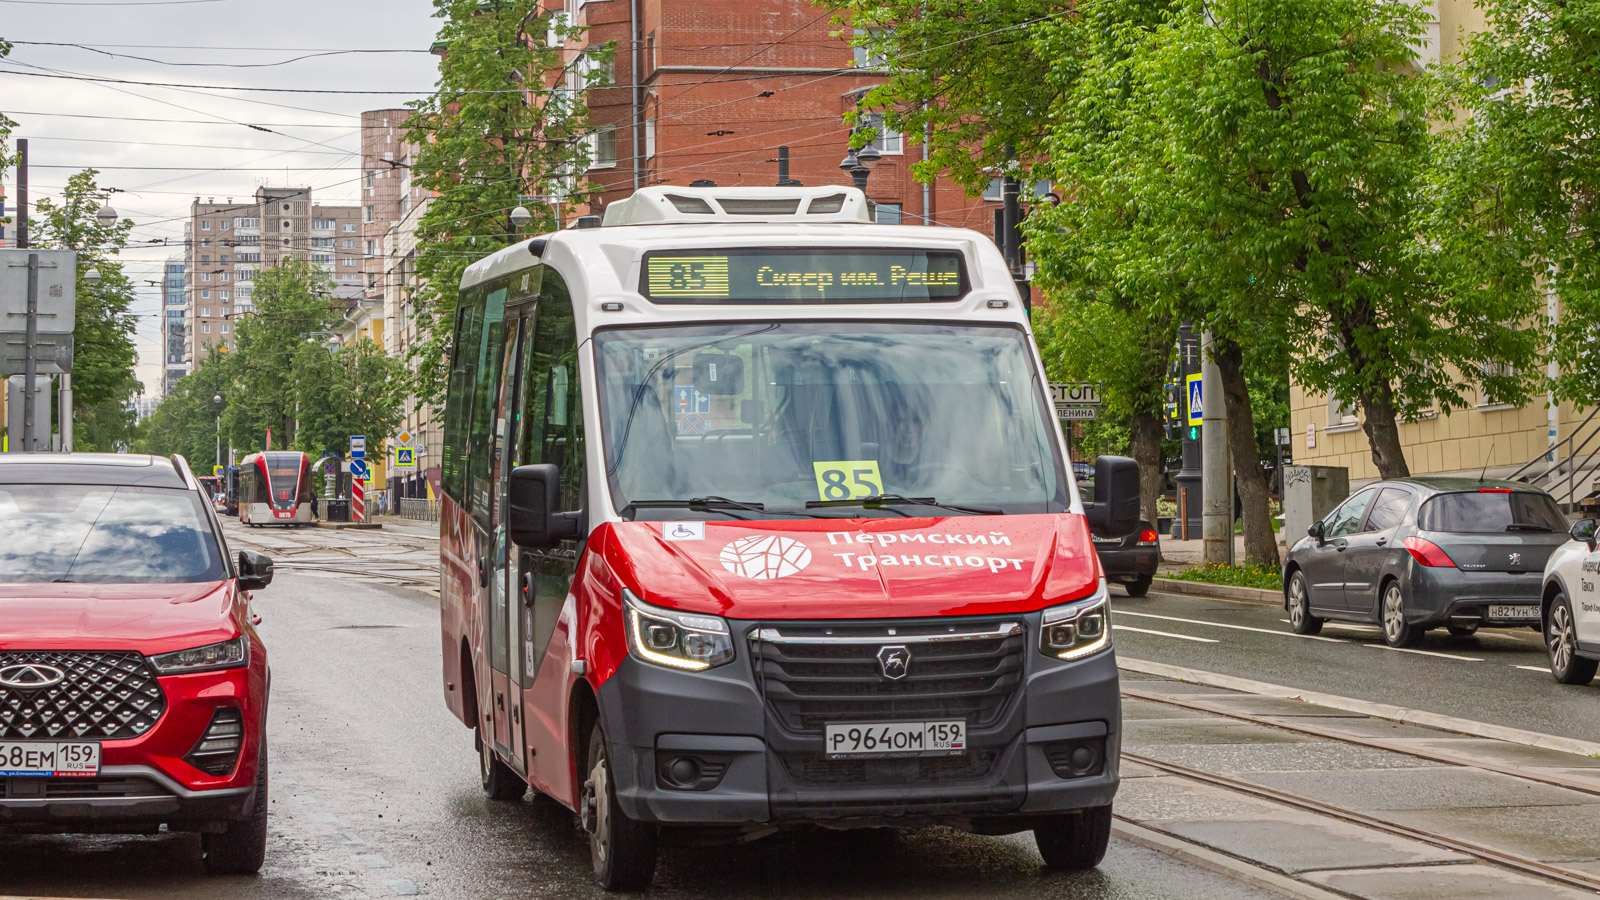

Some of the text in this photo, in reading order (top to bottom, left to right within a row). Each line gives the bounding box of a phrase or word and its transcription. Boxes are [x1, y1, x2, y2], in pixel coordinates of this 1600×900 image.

[669, 263, 706, 290] 85
[756, 266, 833, 291] Сквер
[841, 272, 885, 286] им.
[821, 469, 879, 501] 85
[826, 531, 1012, 547] Пермский
[834, 552, 1024, 573] Транспорт
[1581, 577, 1595, 592] Такси
[1491, 606, 1542, 617] Н821УН 15
[833, 724, 961, 751] Р964ОМ 159
[60, 745, 93, 762] 159
